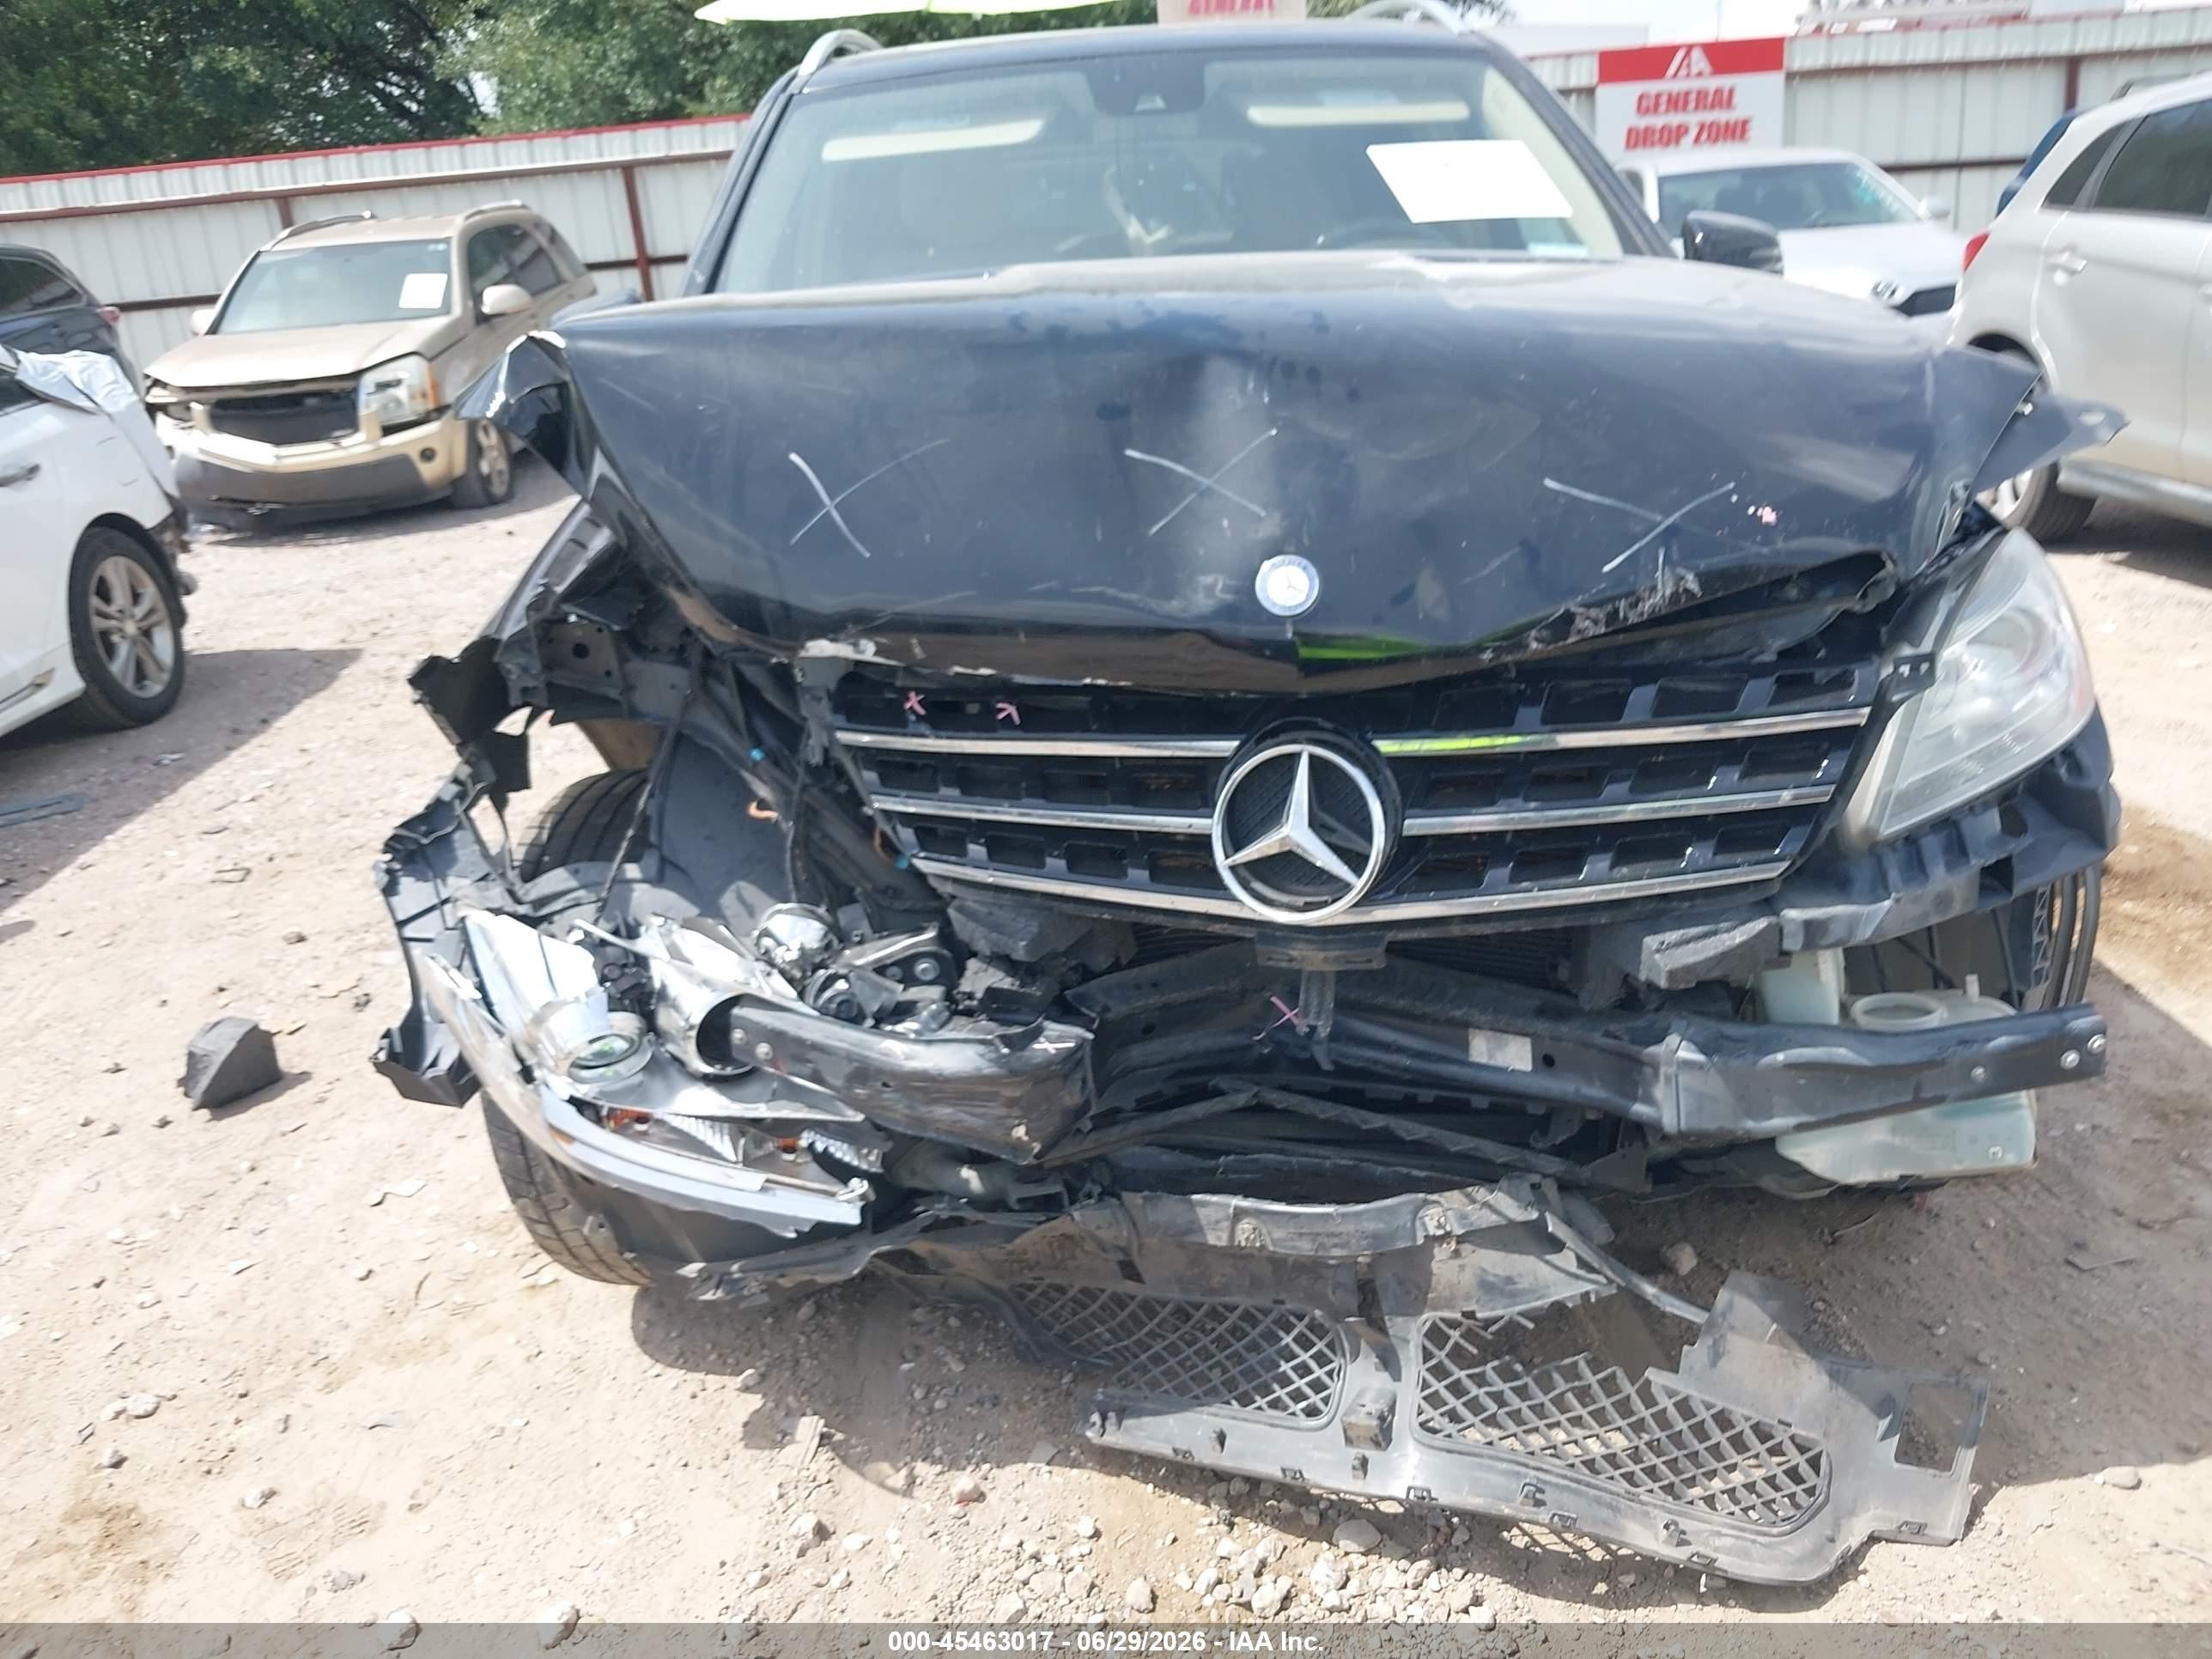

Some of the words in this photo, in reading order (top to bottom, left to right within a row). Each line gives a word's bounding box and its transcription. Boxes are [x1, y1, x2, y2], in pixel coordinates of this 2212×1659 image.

[1636, 85, 1736, 116] GENERAL
[1625, 122, 1689, 150] DROP
[1693, 117, 1753, 147] ZONE
